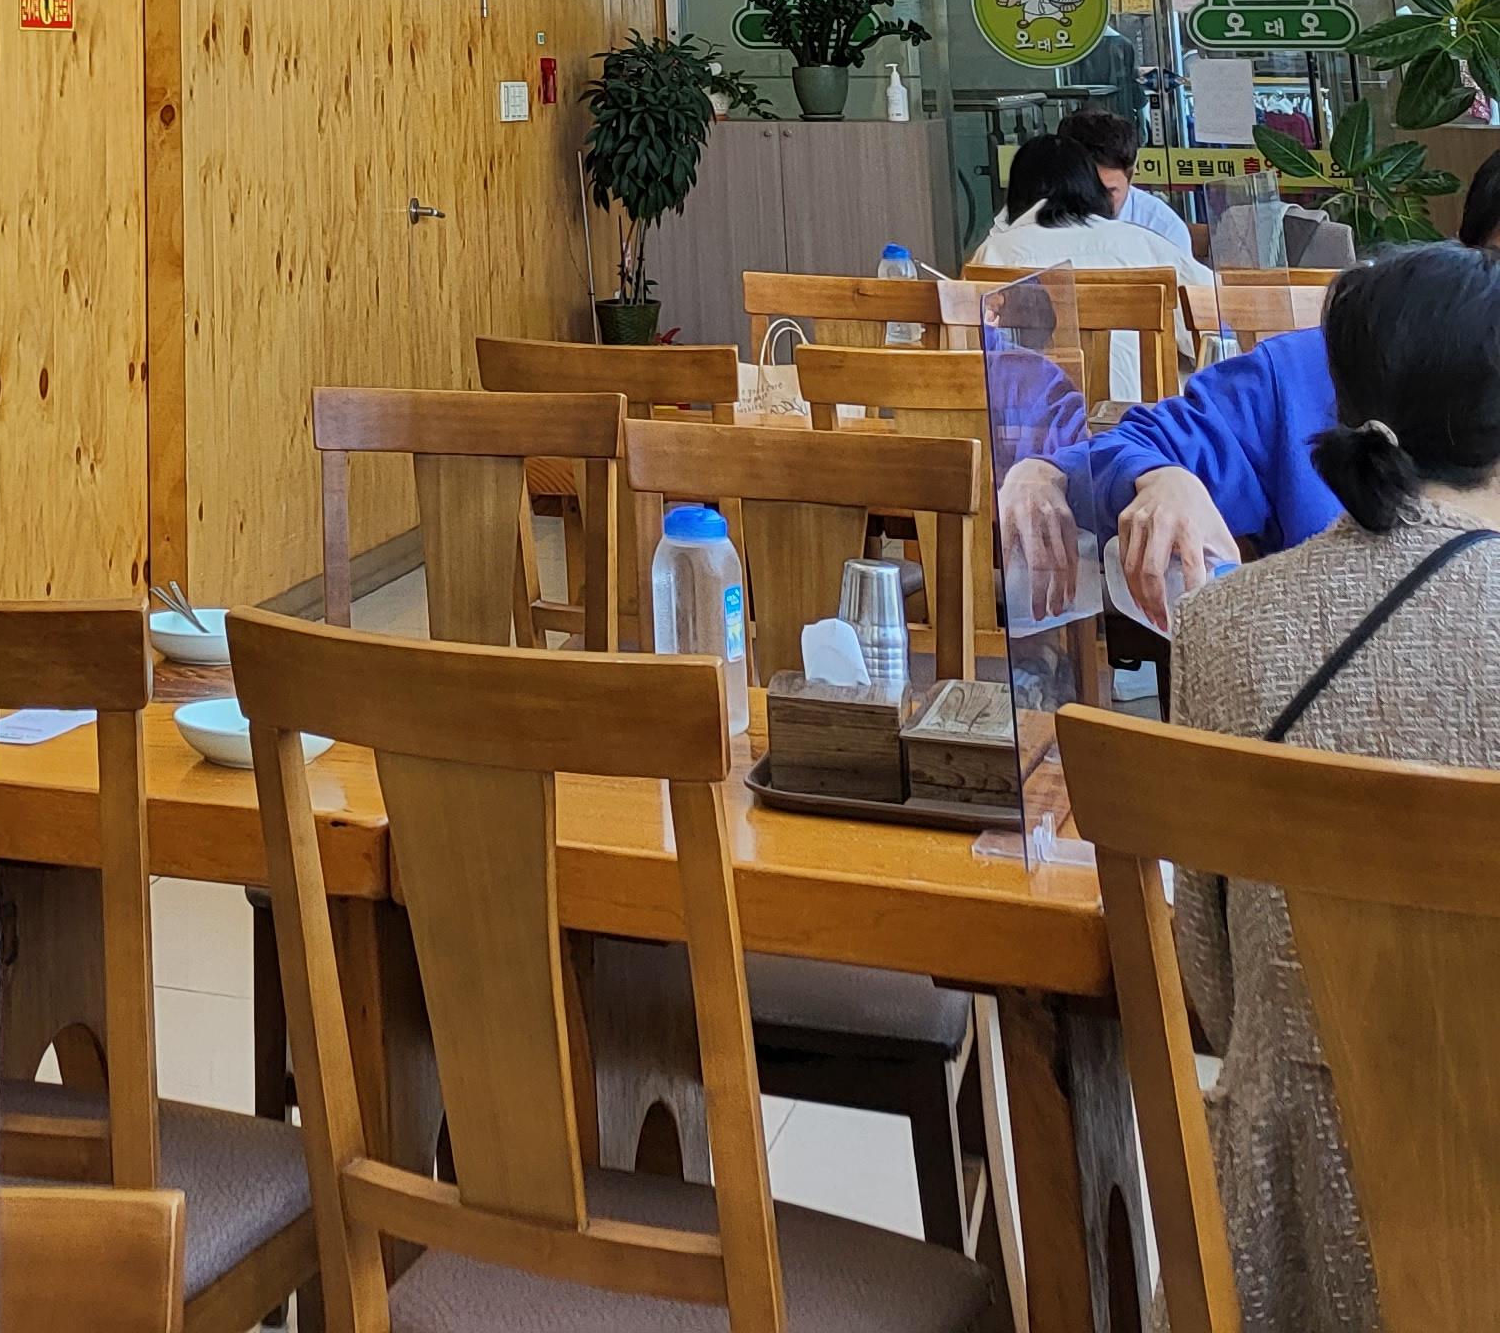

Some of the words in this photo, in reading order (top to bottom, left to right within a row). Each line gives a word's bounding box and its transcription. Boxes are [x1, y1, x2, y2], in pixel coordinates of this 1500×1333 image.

[1224, 12, 1327, 38] 오대오
[1015, 30, 1075, 53] 오대오
[1177, 159, 1235, 177] 열릴때
